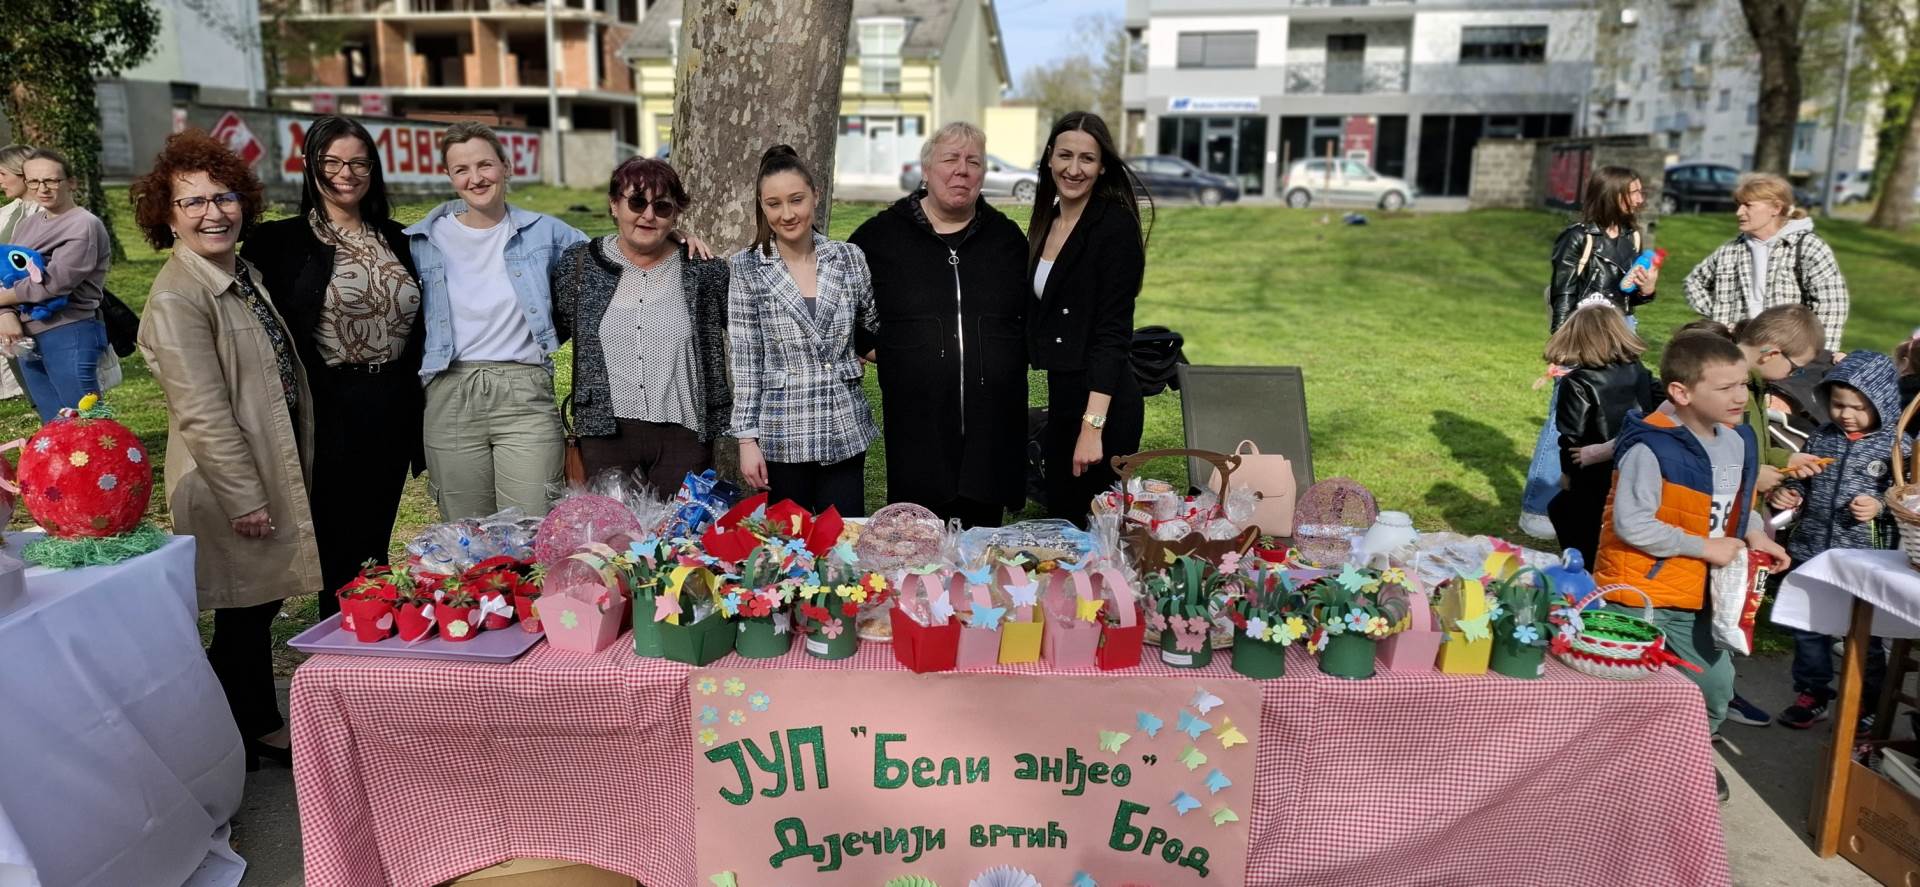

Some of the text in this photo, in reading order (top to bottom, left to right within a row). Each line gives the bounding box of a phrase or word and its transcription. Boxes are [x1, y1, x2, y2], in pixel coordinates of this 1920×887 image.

[704, 726, 829, 805] ЈУП
[769, 799, 1210, 878] Дјечији вртић Брод
